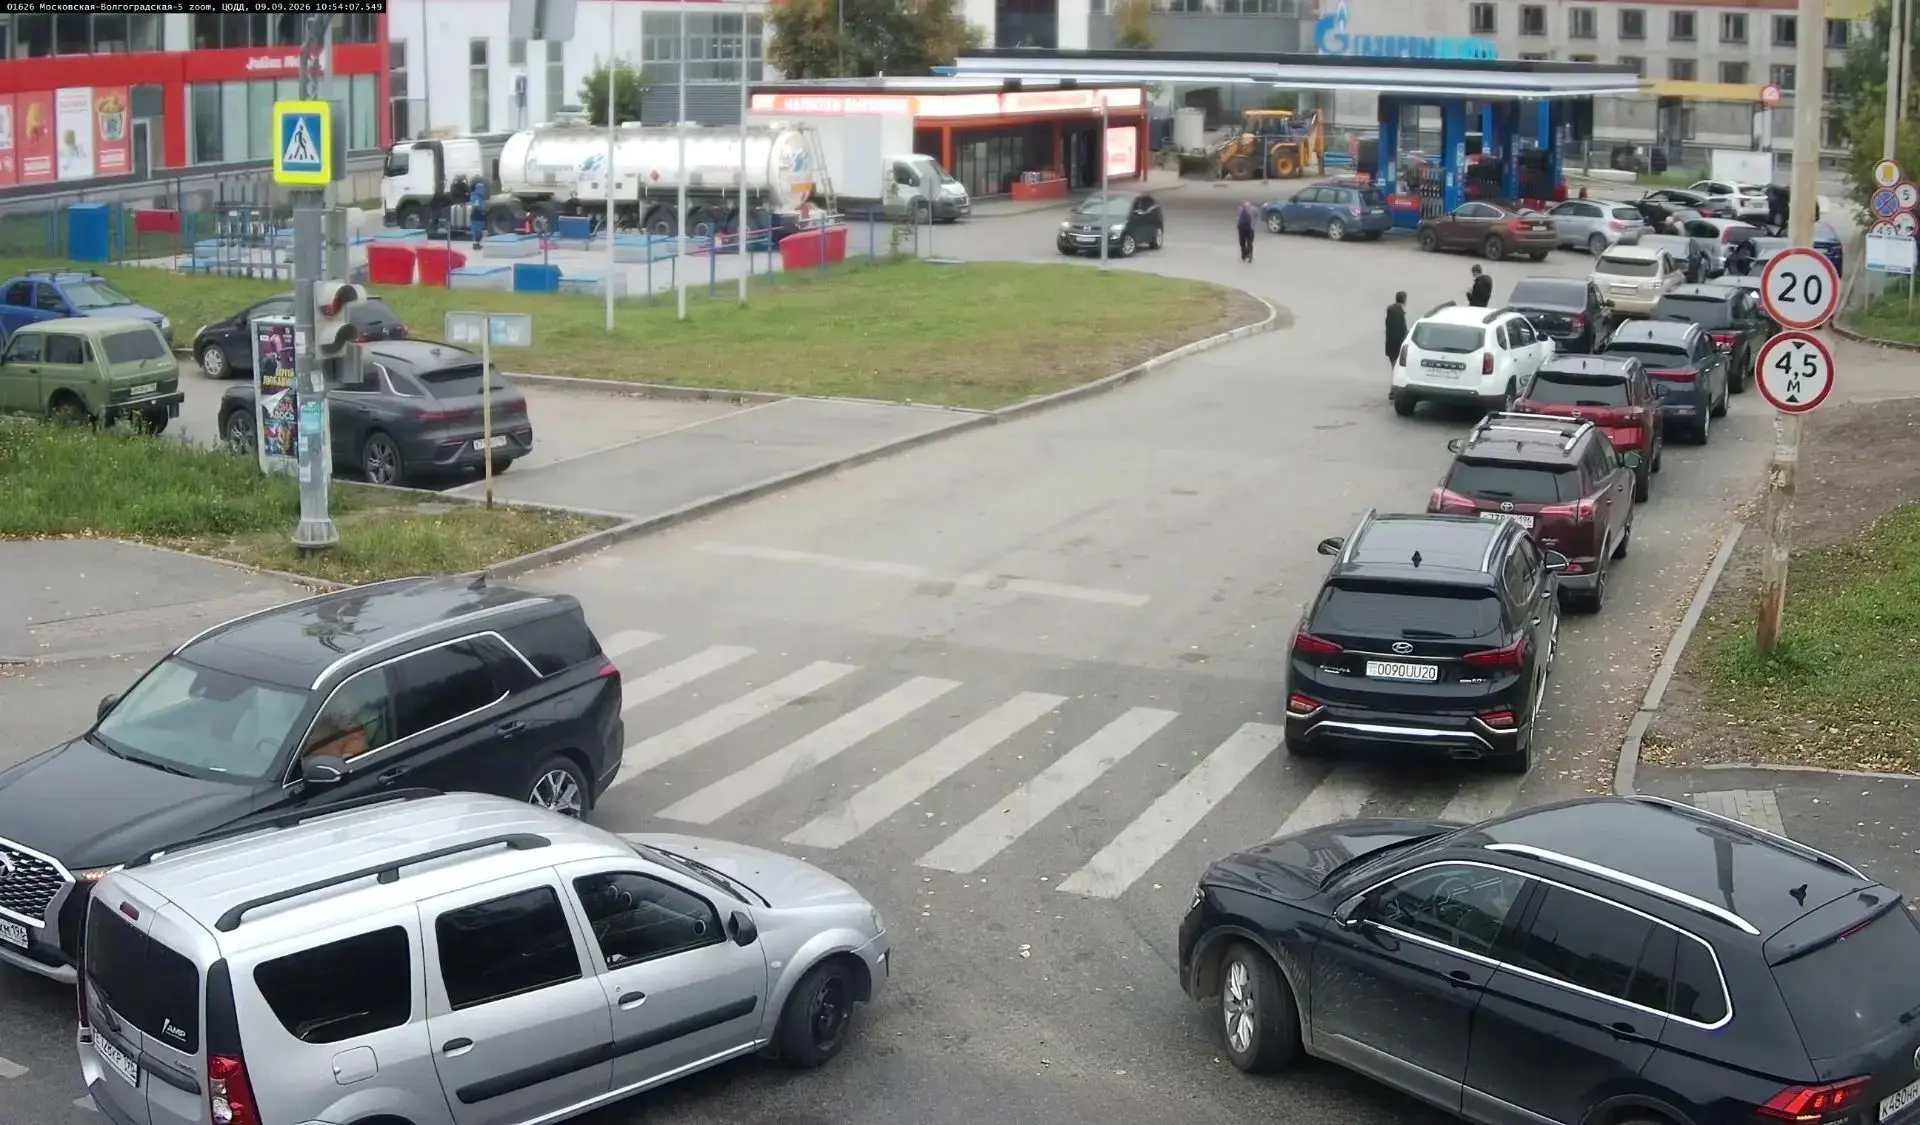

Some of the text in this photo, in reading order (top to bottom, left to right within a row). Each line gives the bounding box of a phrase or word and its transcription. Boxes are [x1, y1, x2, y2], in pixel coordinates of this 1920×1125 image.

[1902, 189, 1911, 202] 5
[1778, 271, 1822, 305] 20
[1775, 351, 1818, 380] 4,5
